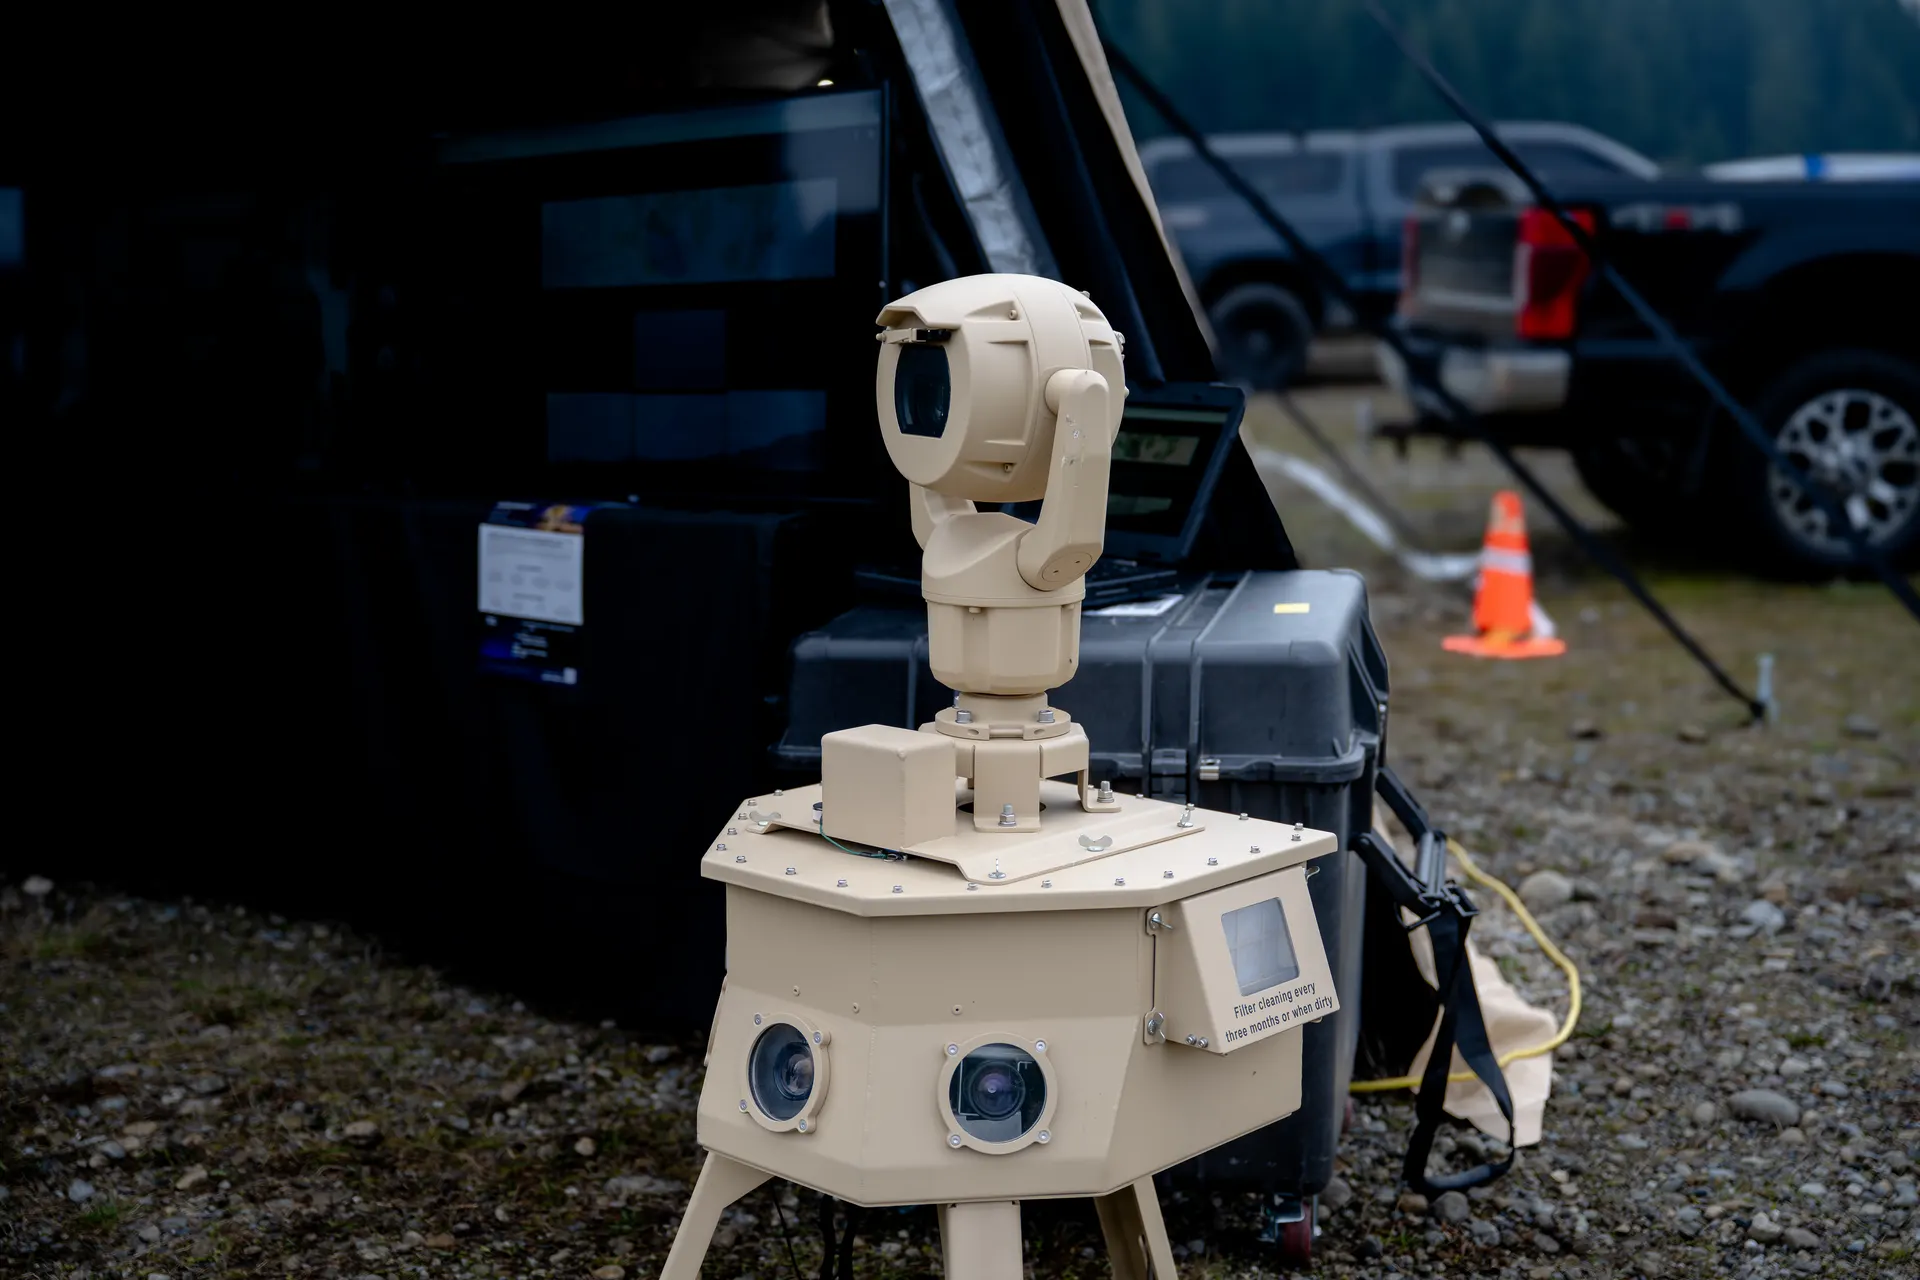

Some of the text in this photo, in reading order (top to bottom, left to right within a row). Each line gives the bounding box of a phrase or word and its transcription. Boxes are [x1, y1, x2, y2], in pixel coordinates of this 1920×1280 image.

[1225, 996, 1333, 1042] three months or when dirty
[1233, 982, 1315, 1018] Filter cleaning every
